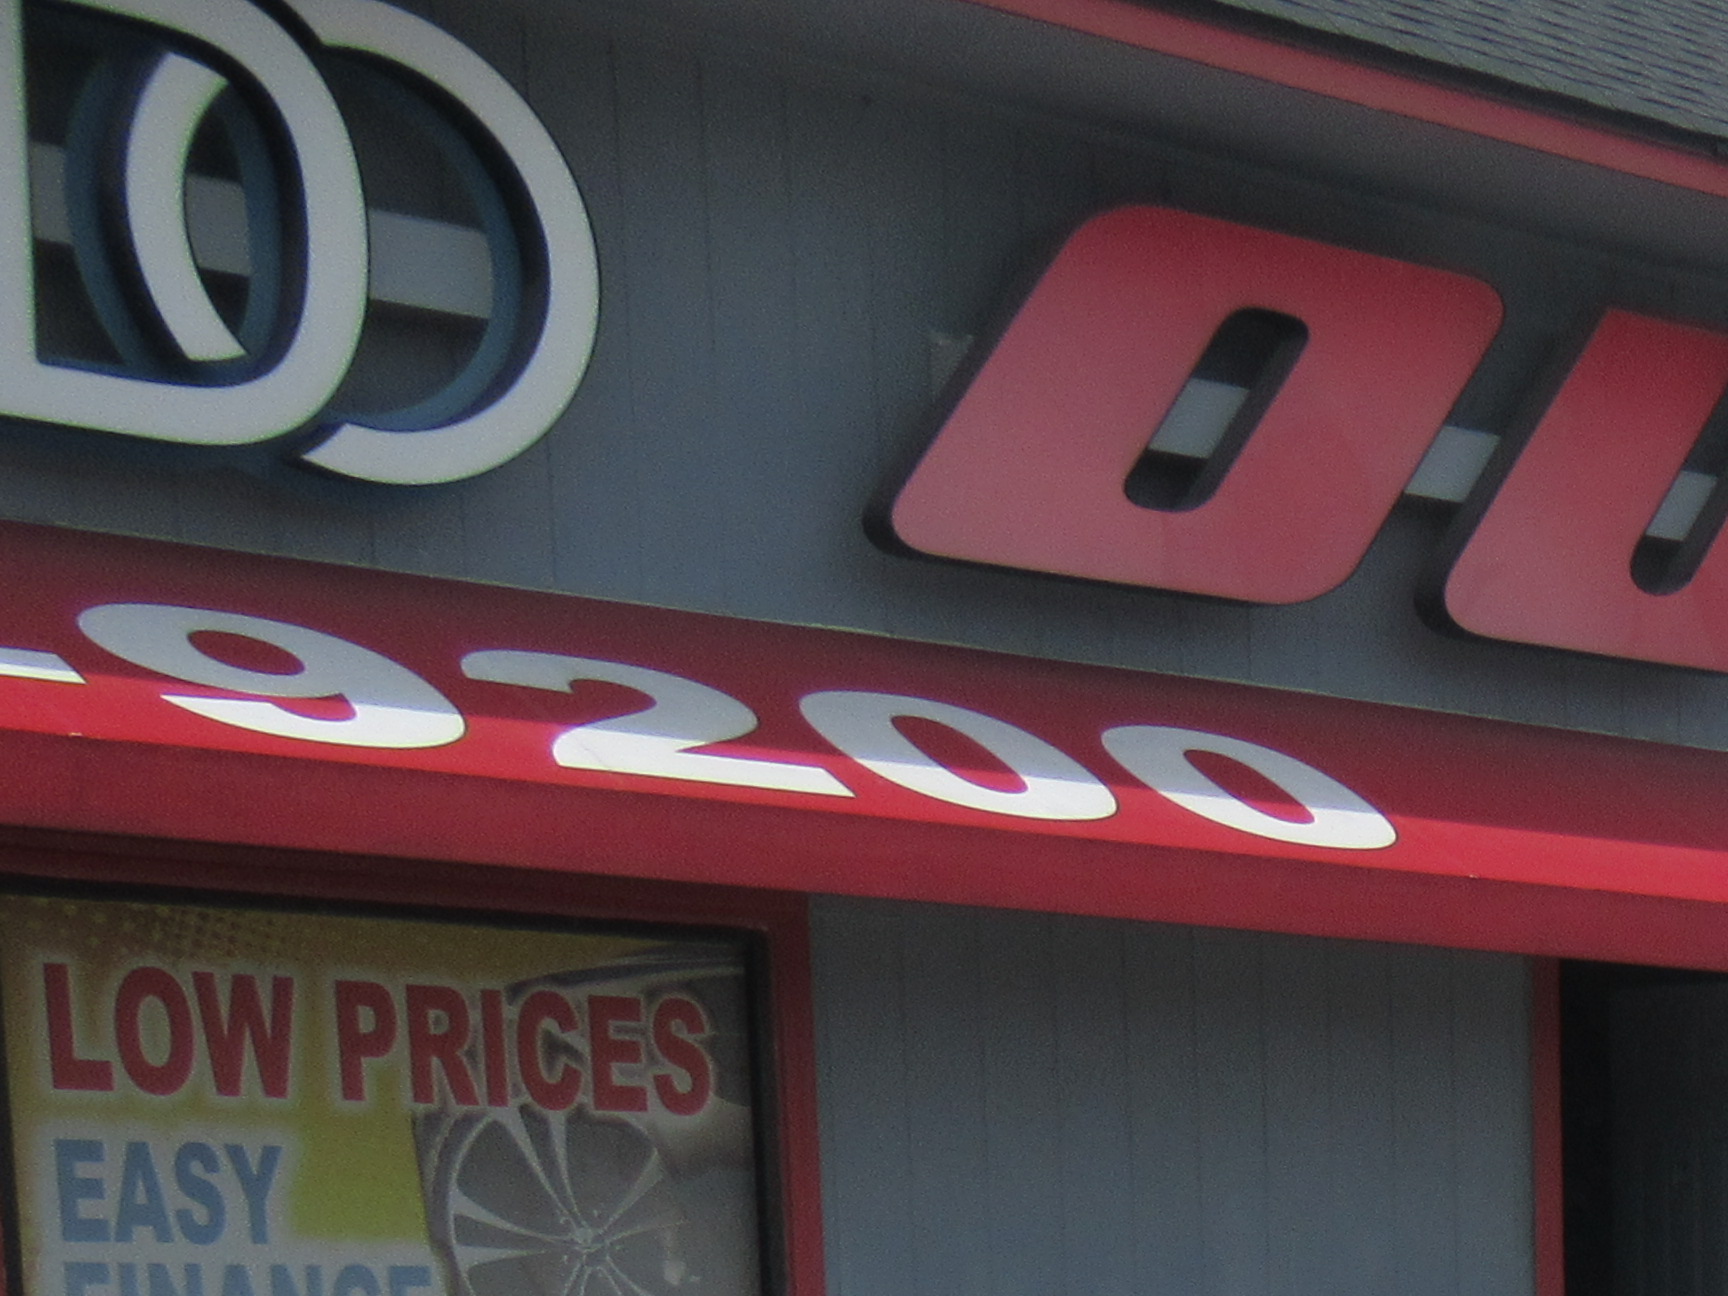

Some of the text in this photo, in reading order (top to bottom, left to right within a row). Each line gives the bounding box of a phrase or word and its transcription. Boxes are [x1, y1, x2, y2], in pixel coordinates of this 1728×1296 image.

[43, 961, 714, 1117] LOW PRICES
[54, 1138, 283, 1246] EASY
